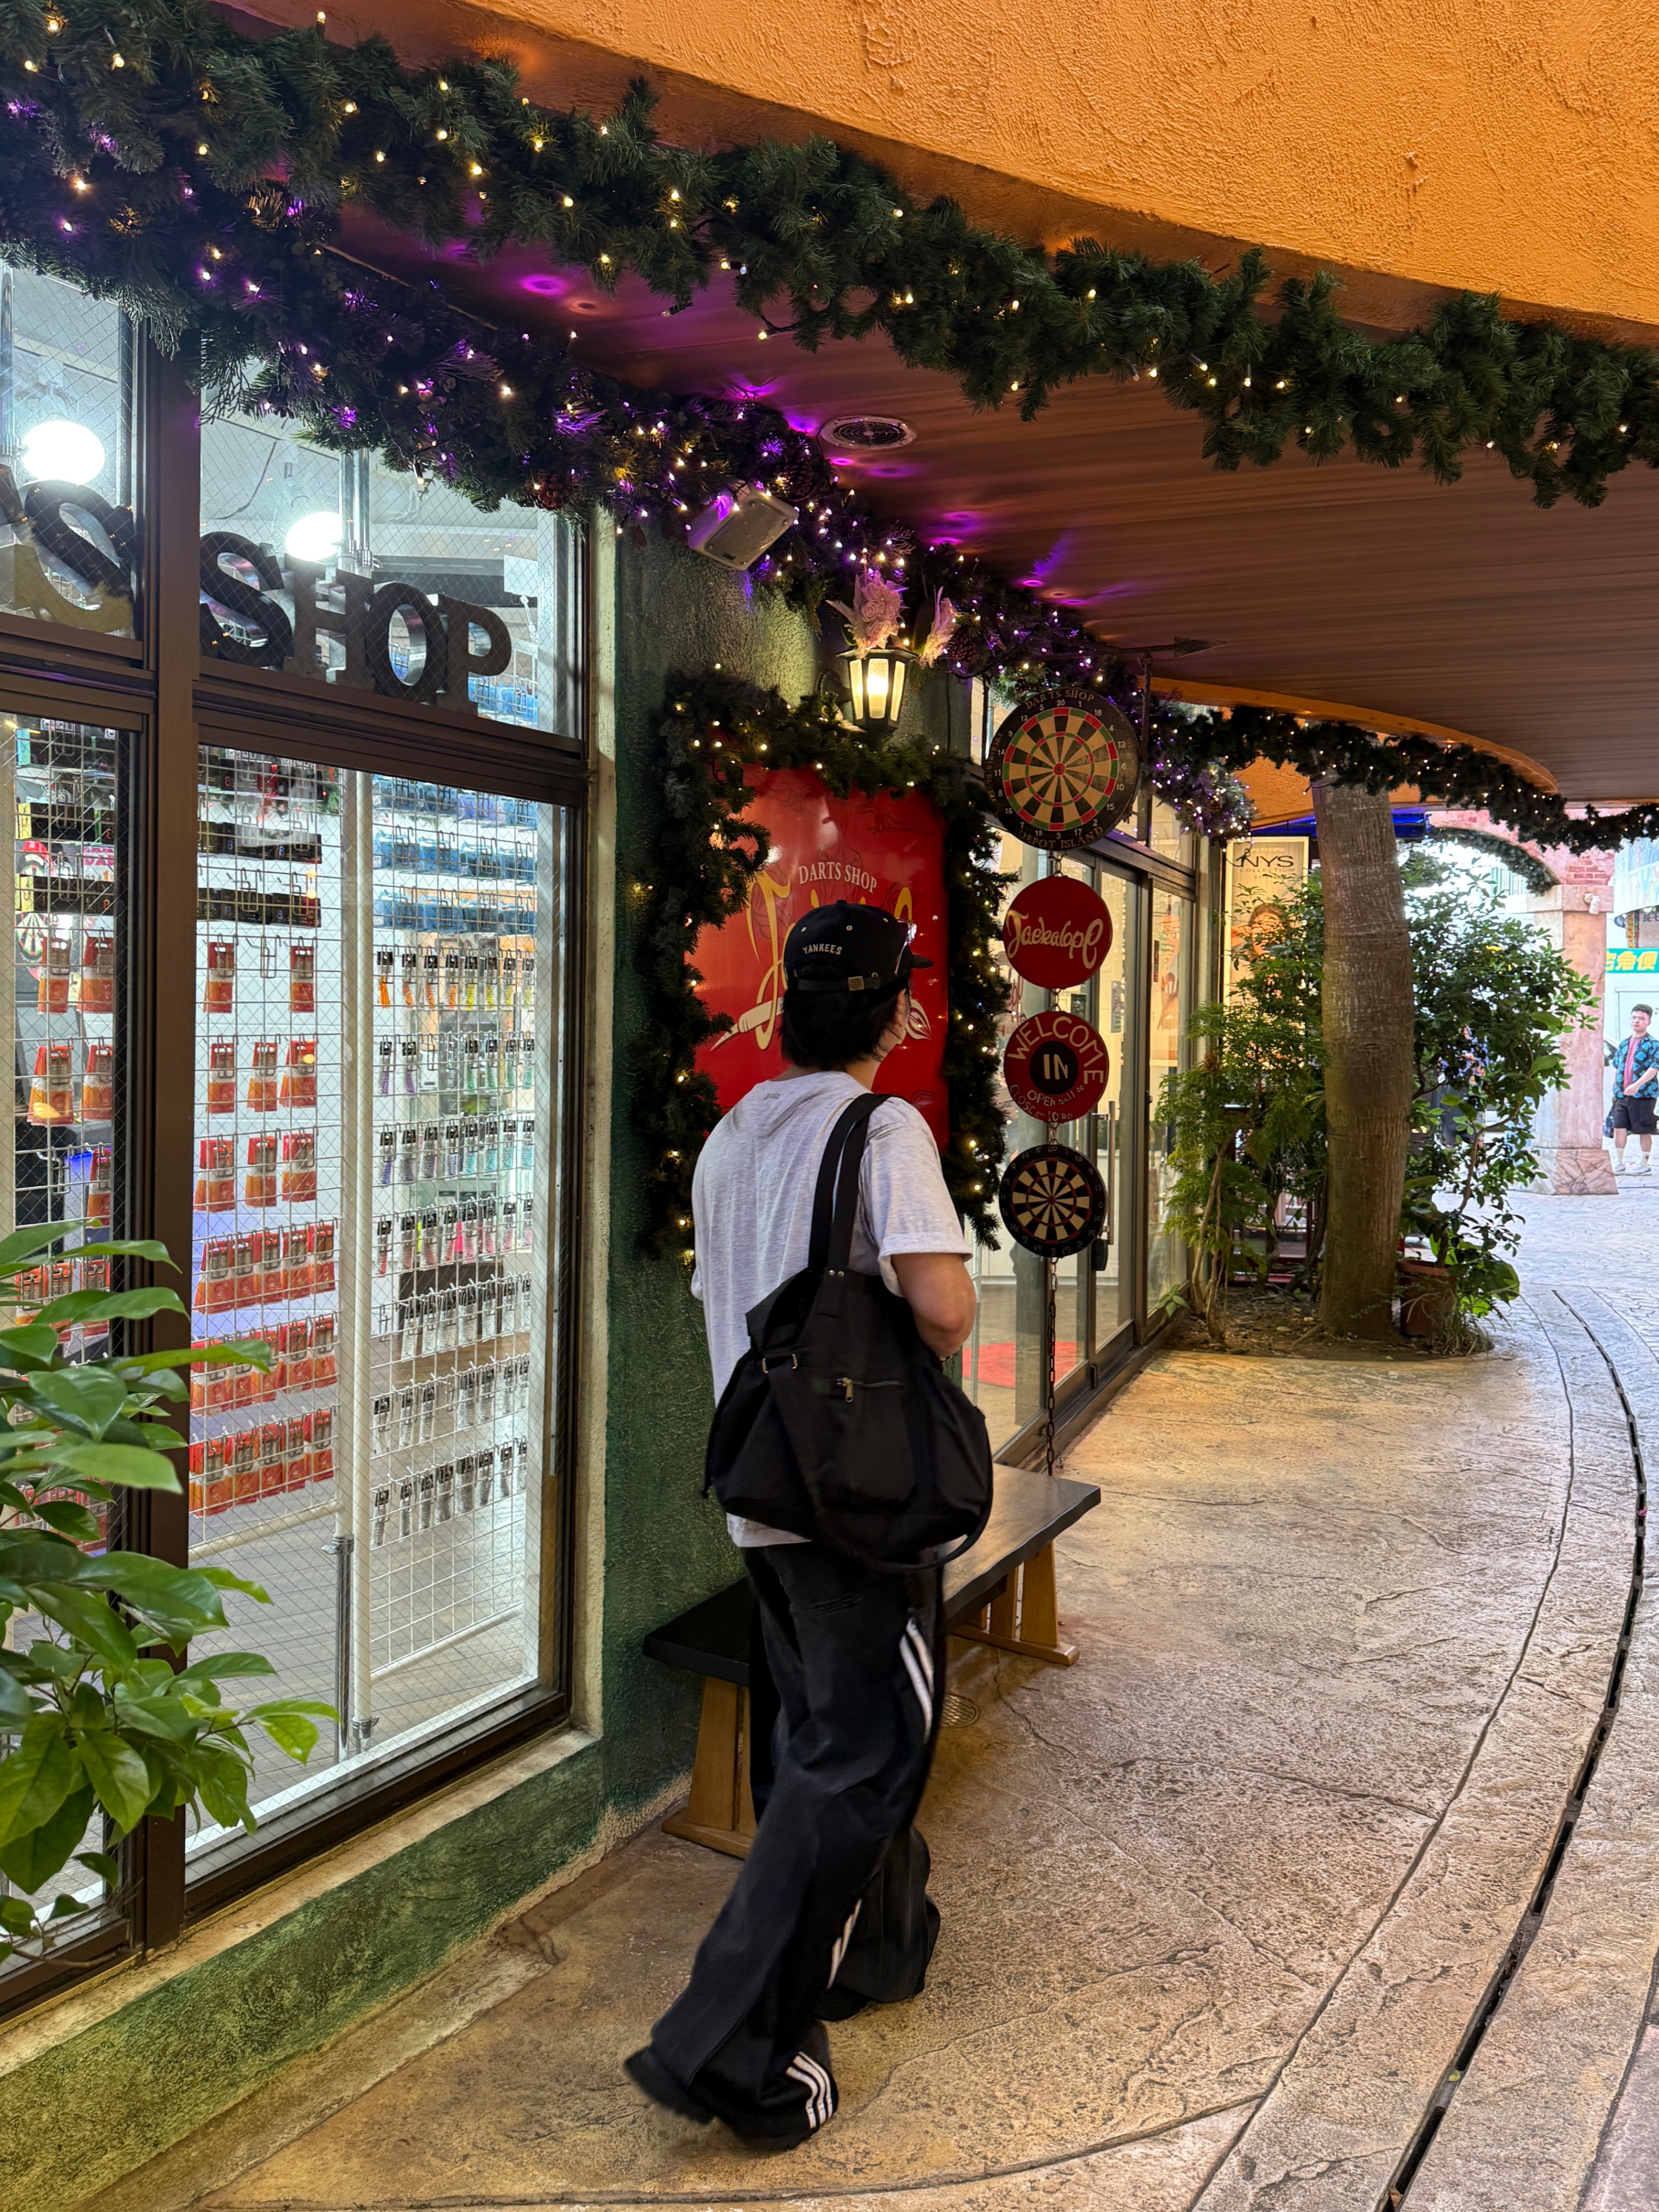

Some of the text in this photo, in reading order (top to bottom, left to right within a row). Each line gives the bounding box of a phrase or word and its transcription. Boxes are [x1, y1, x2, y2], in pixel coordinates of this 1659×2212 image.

[200, 531, 512, 717] SHOP
[1025, 690, 1094, 709] DARTS SHOP
[1018, 826, 1103, 848] DEPOT ISLAND
[1241, 855, 1294, 868] NYS
[798, 862, 877, 894] DARTS SHOP
[803, 943, 842, 955] YANKEES
[1007, 1016, 1104, 1084] WELCOME
[1043, 1054, 1068, 1080] IN
[1010, 1085, 1035, 1114] CLOSE
[1027, 1090, 1055, 1106] OPEN
